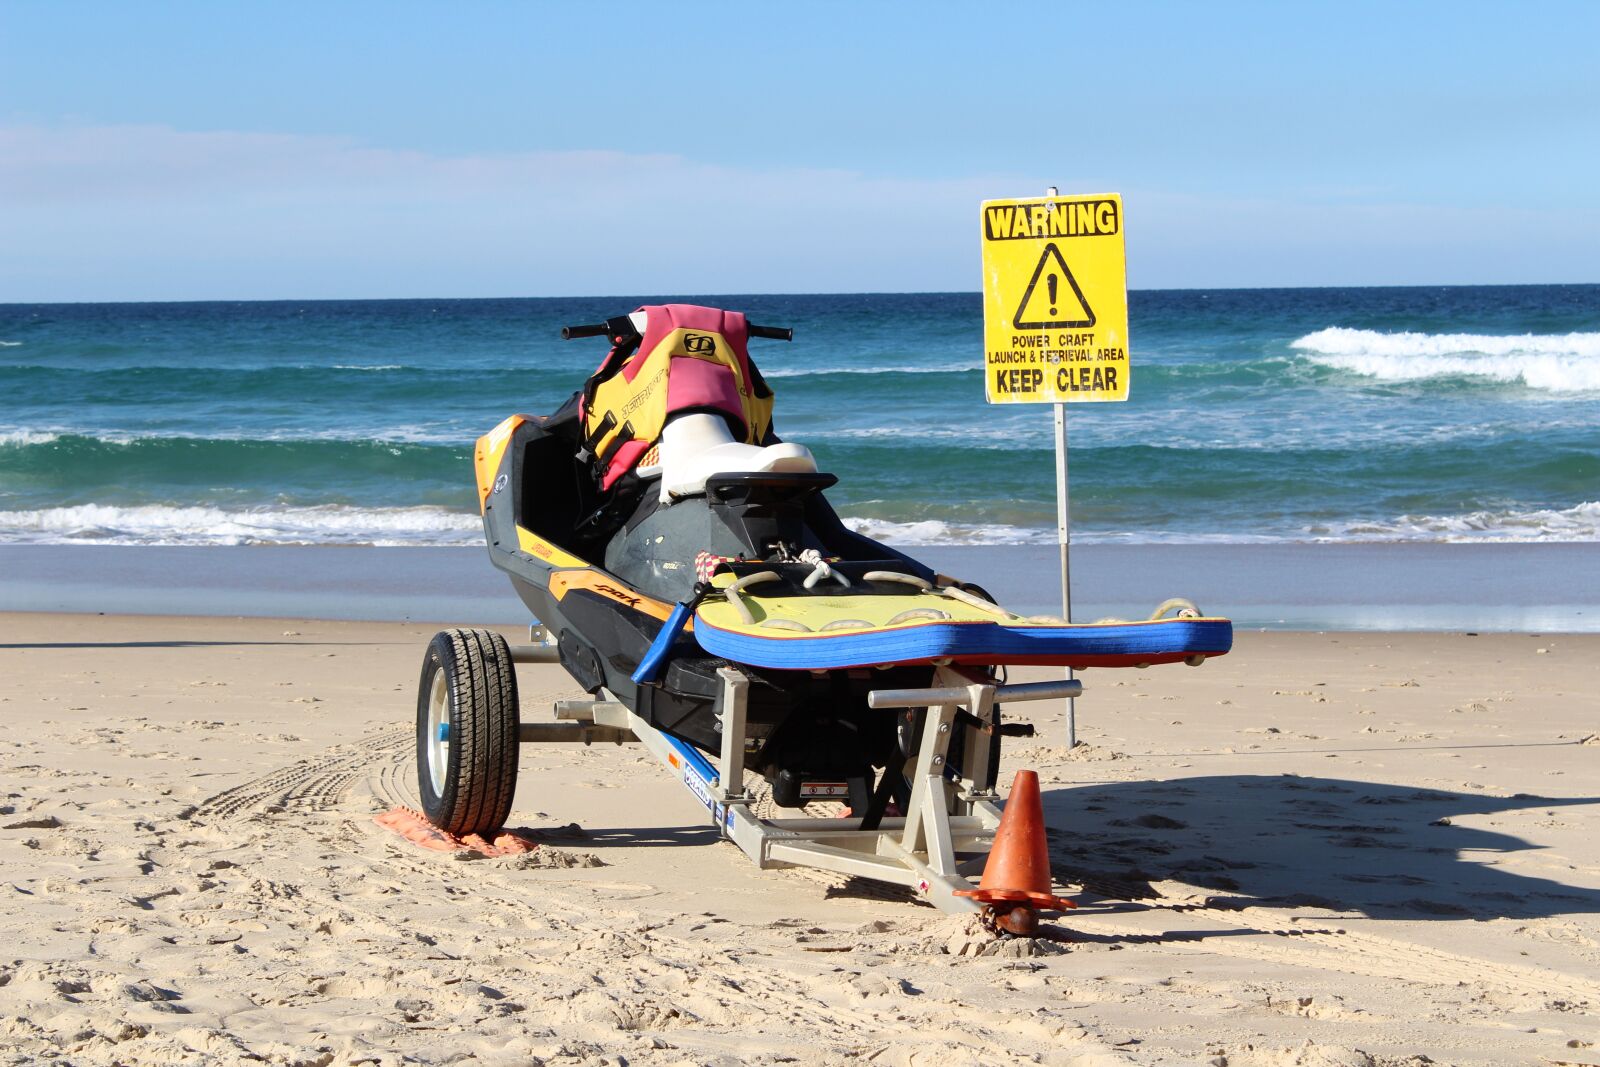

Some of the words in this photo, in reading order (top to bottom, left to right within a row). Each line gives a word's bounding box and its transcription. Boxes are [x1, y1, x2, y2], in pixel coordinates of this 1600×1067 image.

[988, 202, 1116, 239] WARNING
[1012, 335, 1050, 348] POWER
[1059, 333, 1095, 347] CRAFT
[988, 350, 1026, 364] LAUNCH
[1029, 350, 1036, 363] &
[1039, 348, 1093, 364] RETRIEVAL
[1096, 348, 1125, 361] AREA
[621, 368, 665, 420] JETPIT
[996, 369, 1043, 394] KEEP
[1056, 367, 1118, 392] CLEAR
